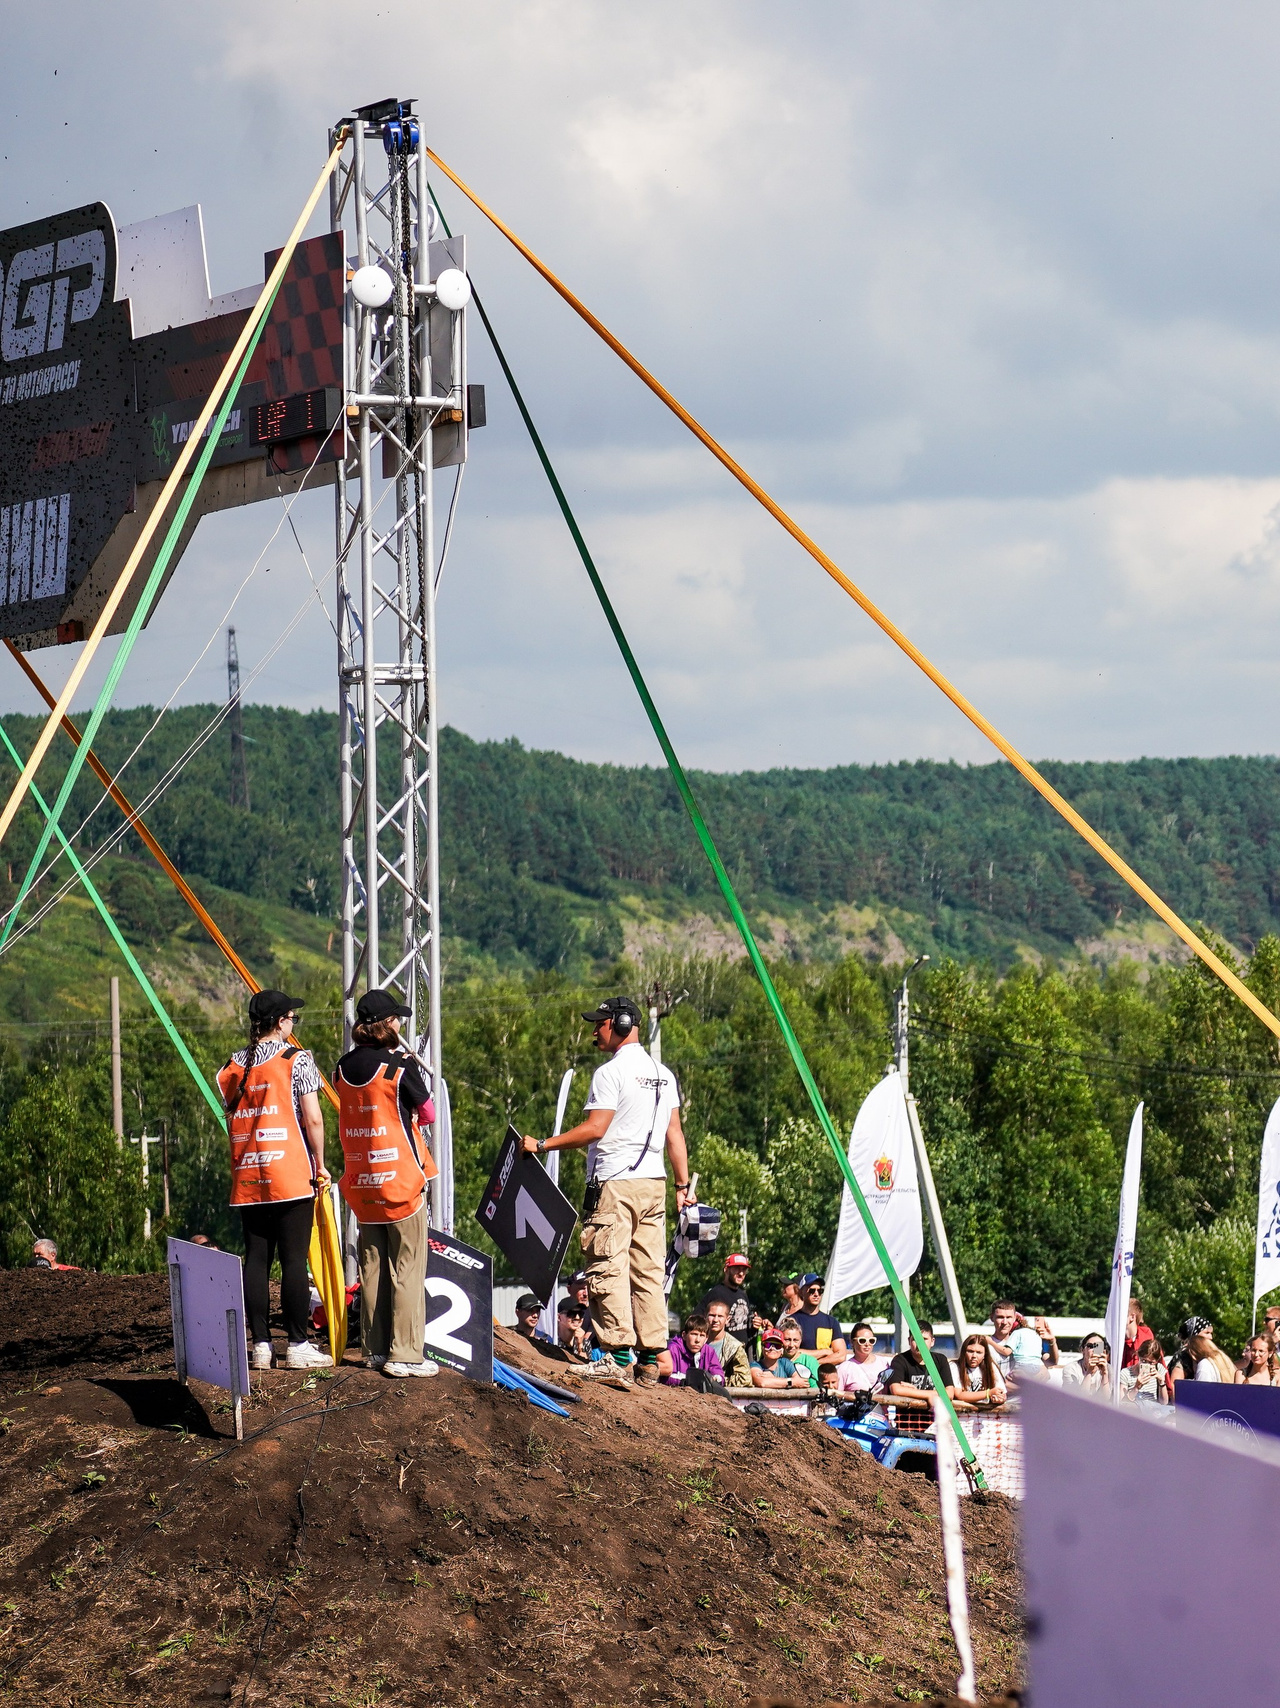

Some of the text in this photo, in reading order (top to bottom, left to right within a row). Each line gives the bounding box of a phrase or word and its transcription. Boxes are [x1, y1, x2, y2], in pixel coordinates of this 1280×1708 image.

[0, 229, 106, 362] GP
[258, 394, 314, 440] LAP 1
[233, 1105, 278, 1119] МАРШАЛ
[345, 1125, 387, 1138] МАРШАЛ
[241, 1150, 285, 1165] RGP
[357, 1171, 397, 1185] RGP
[444, 1246, 484, 1270] RGP
[424, 1277, 472, 1361] 2
